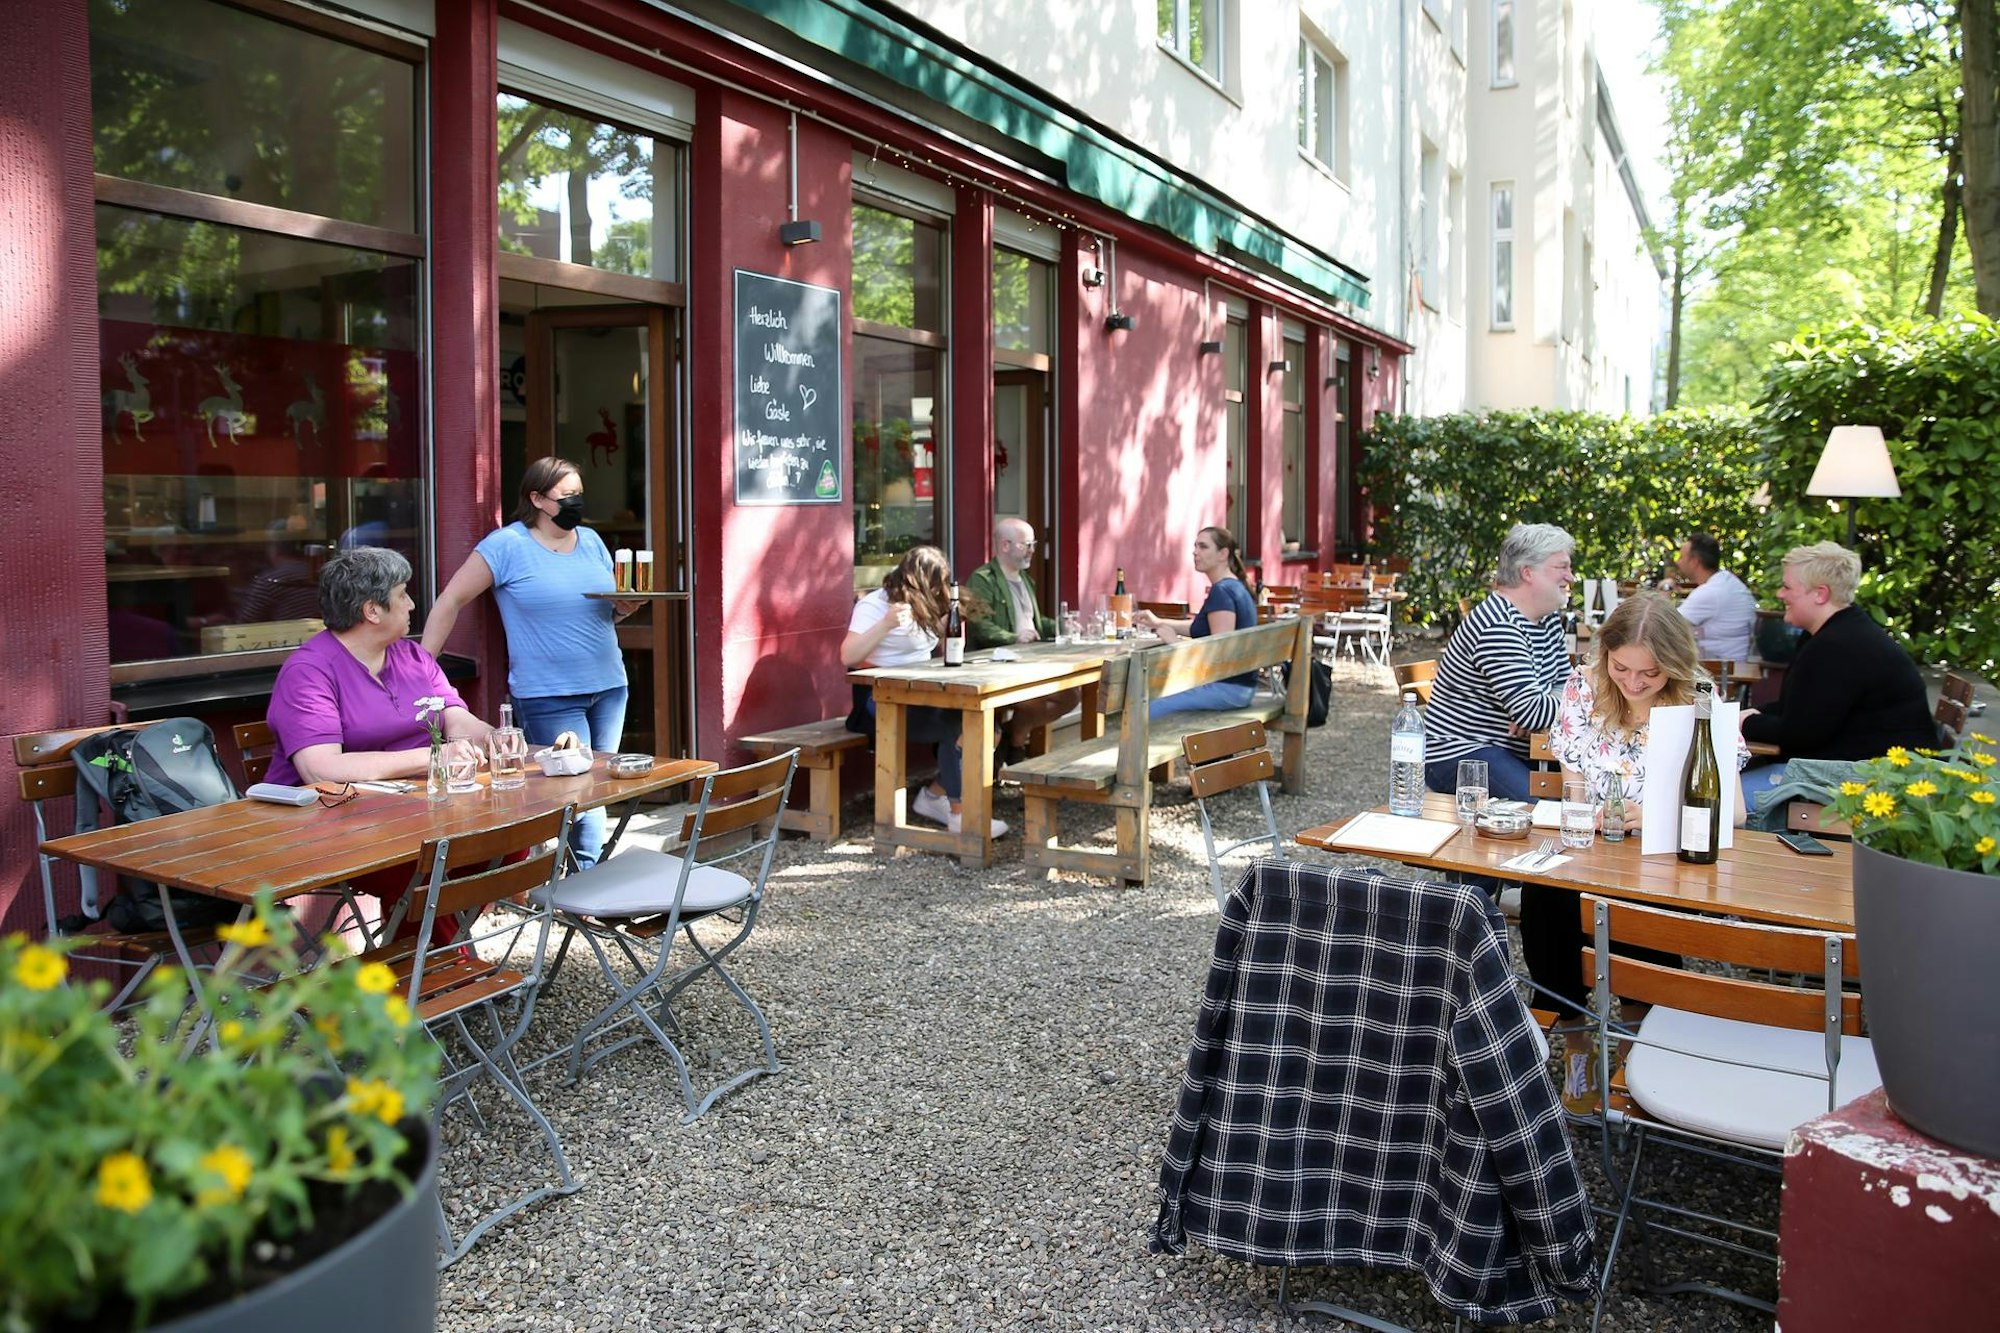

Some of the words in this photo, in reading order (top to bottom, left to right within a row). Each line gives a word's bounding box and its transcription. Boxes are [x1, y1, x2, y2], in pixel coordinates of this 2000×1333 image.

[749, 305, 788, 330] Herzlich
[764, 342, 816, 369] Willkommen
[750, 374, 770, 395] Liebe
[765, 398, 790, 422] Gäste
